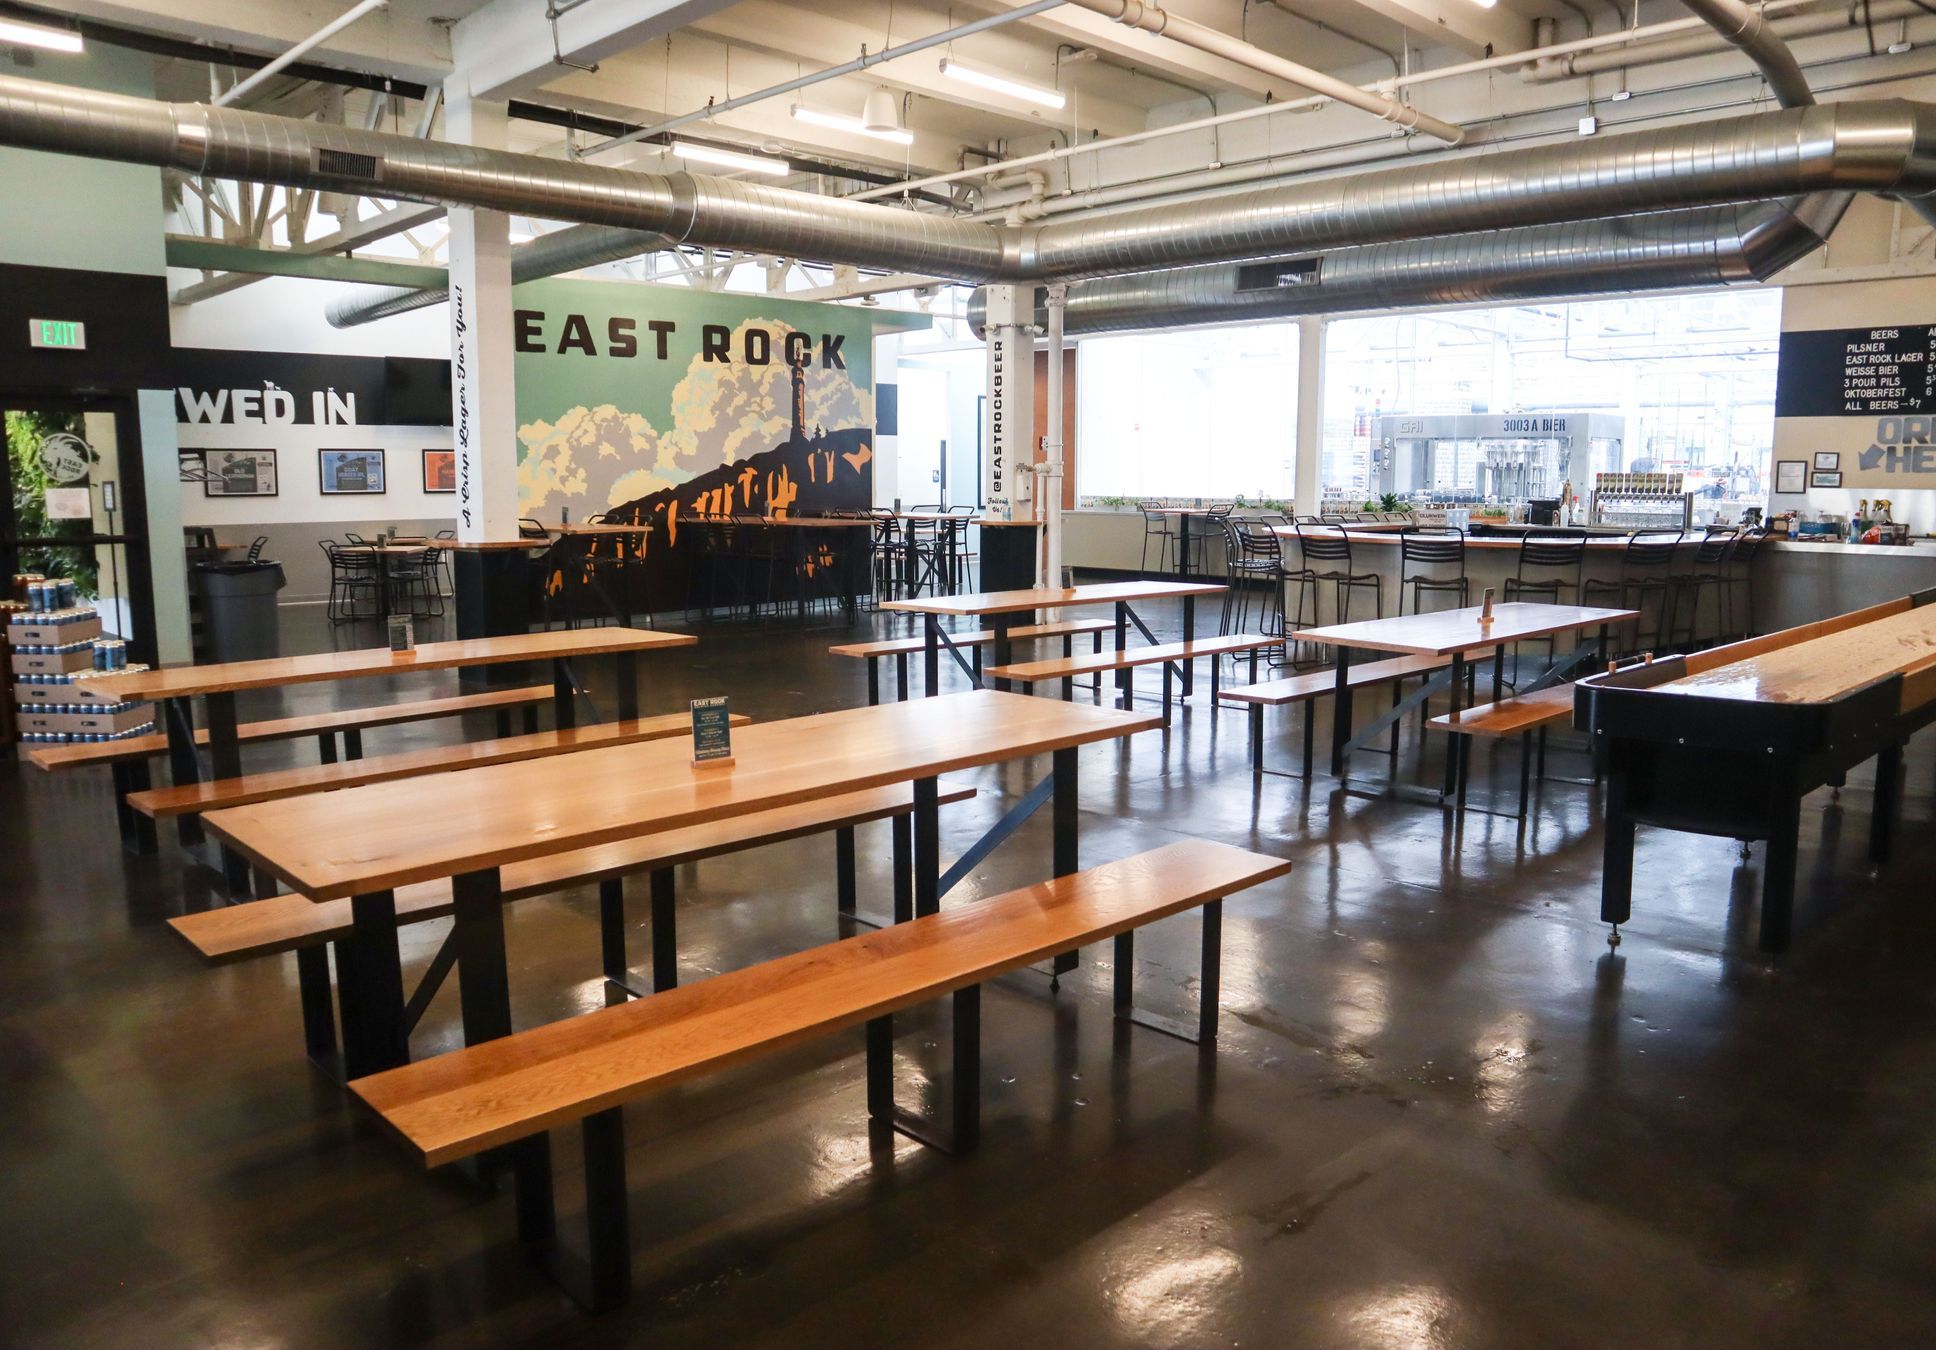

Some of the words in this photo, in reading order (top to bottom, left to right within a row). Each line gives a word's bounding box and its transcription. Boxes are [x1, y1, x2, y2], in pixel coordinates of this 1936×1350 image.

[454, 285, 467, 338] You!
[41, 320, 78, 346] EXIT
[1870, 330, 1899, 340] BEERS
[513, 309, 676, 361] EAST
[702, 323, 847, 371] ROCK
[1846, 343, 1886, 353] PILSNER
[1845, 356, 1867, 365] EAST
[1869, 354, 1892, 363] ROCK
[1894, 353, 1924, 362] LAGER
[1845, 367, 1876, 376] WEISSE
[1878, 365, 1899, 375] BIER
[1844, 379, 1850, 387] 3
[1852, 378, 1877, 387] POUR
[1880, 377, 1900, 386] PILS
[1844, 388, 1906, 398] OKTOBERFEST
[1925, 387, 1932, 396] 6
[312, 391, 357, 425] IN
[1845, 401, 1862, 410] ALL
[458, 383, 470, 448] Lager
[993, 341, 1003, 492] @EASTROCKBEER
[1503, 419, 1530, 431] 3003
[1531, 419, 1538, 431] A
[1543, 418, 1566, 431] BIER
[461, 451, 470, 504] Crisp
[462, 507, 471, 528] A
